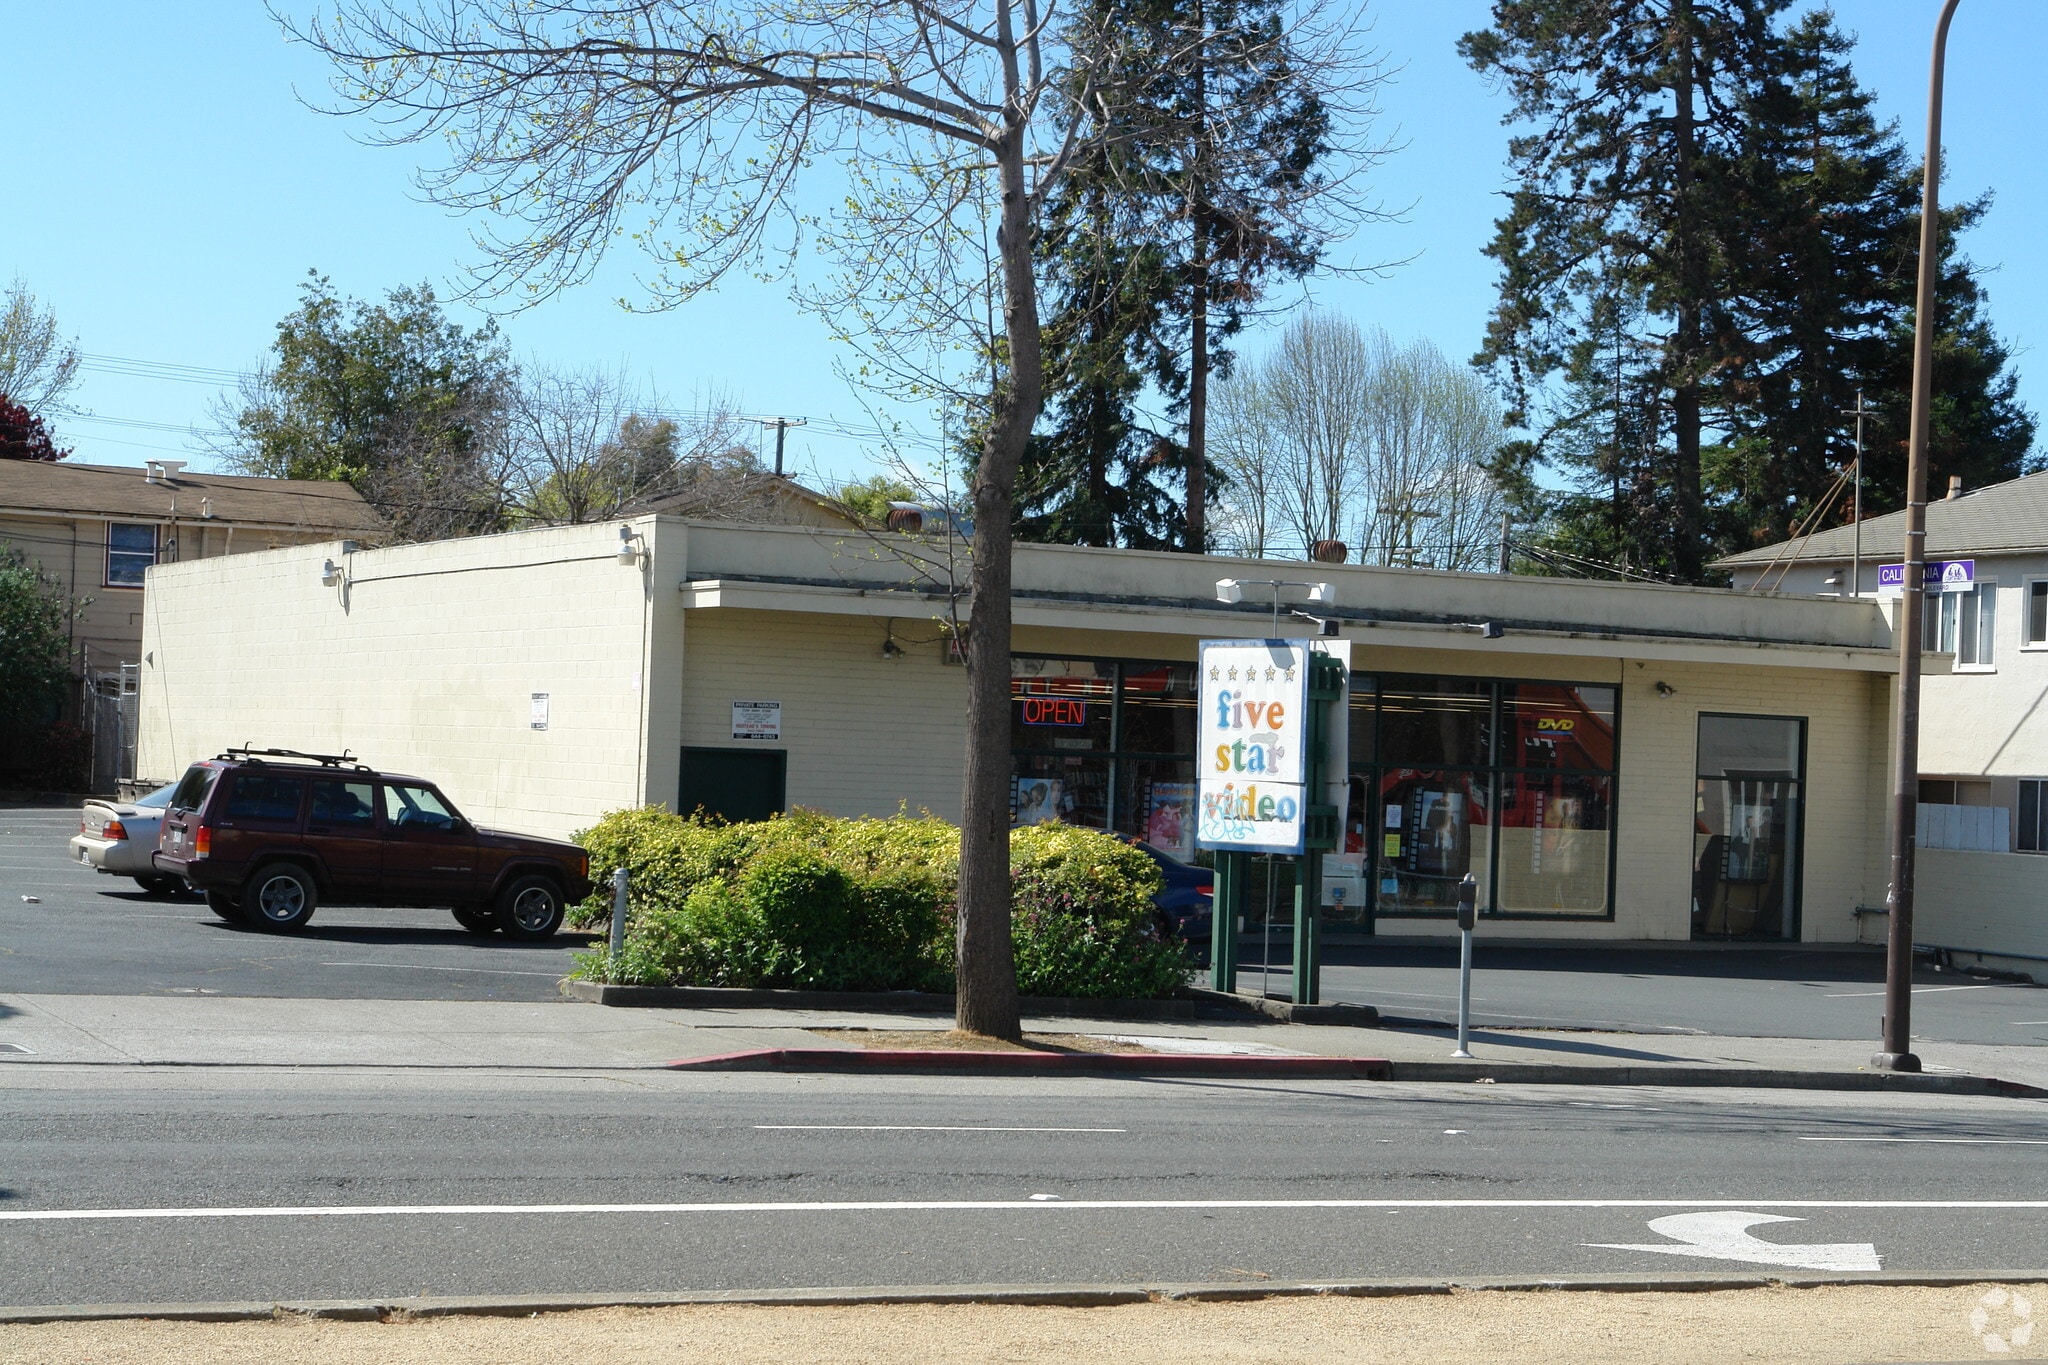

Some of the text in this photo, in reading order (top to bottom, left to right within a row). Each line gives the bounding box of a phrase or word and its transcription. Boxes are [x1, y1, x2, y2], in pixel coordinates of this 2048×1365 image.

[1882, 566, 1939, 582] CALINIA
[1025, 699, 1083, 724] OPEN
[1217, 690, 1284, 729] five
[1537, 718, 1575, 730] DVD
[1216, 738, 1285, 773] star
[1204, 783, 1297, 821] video
